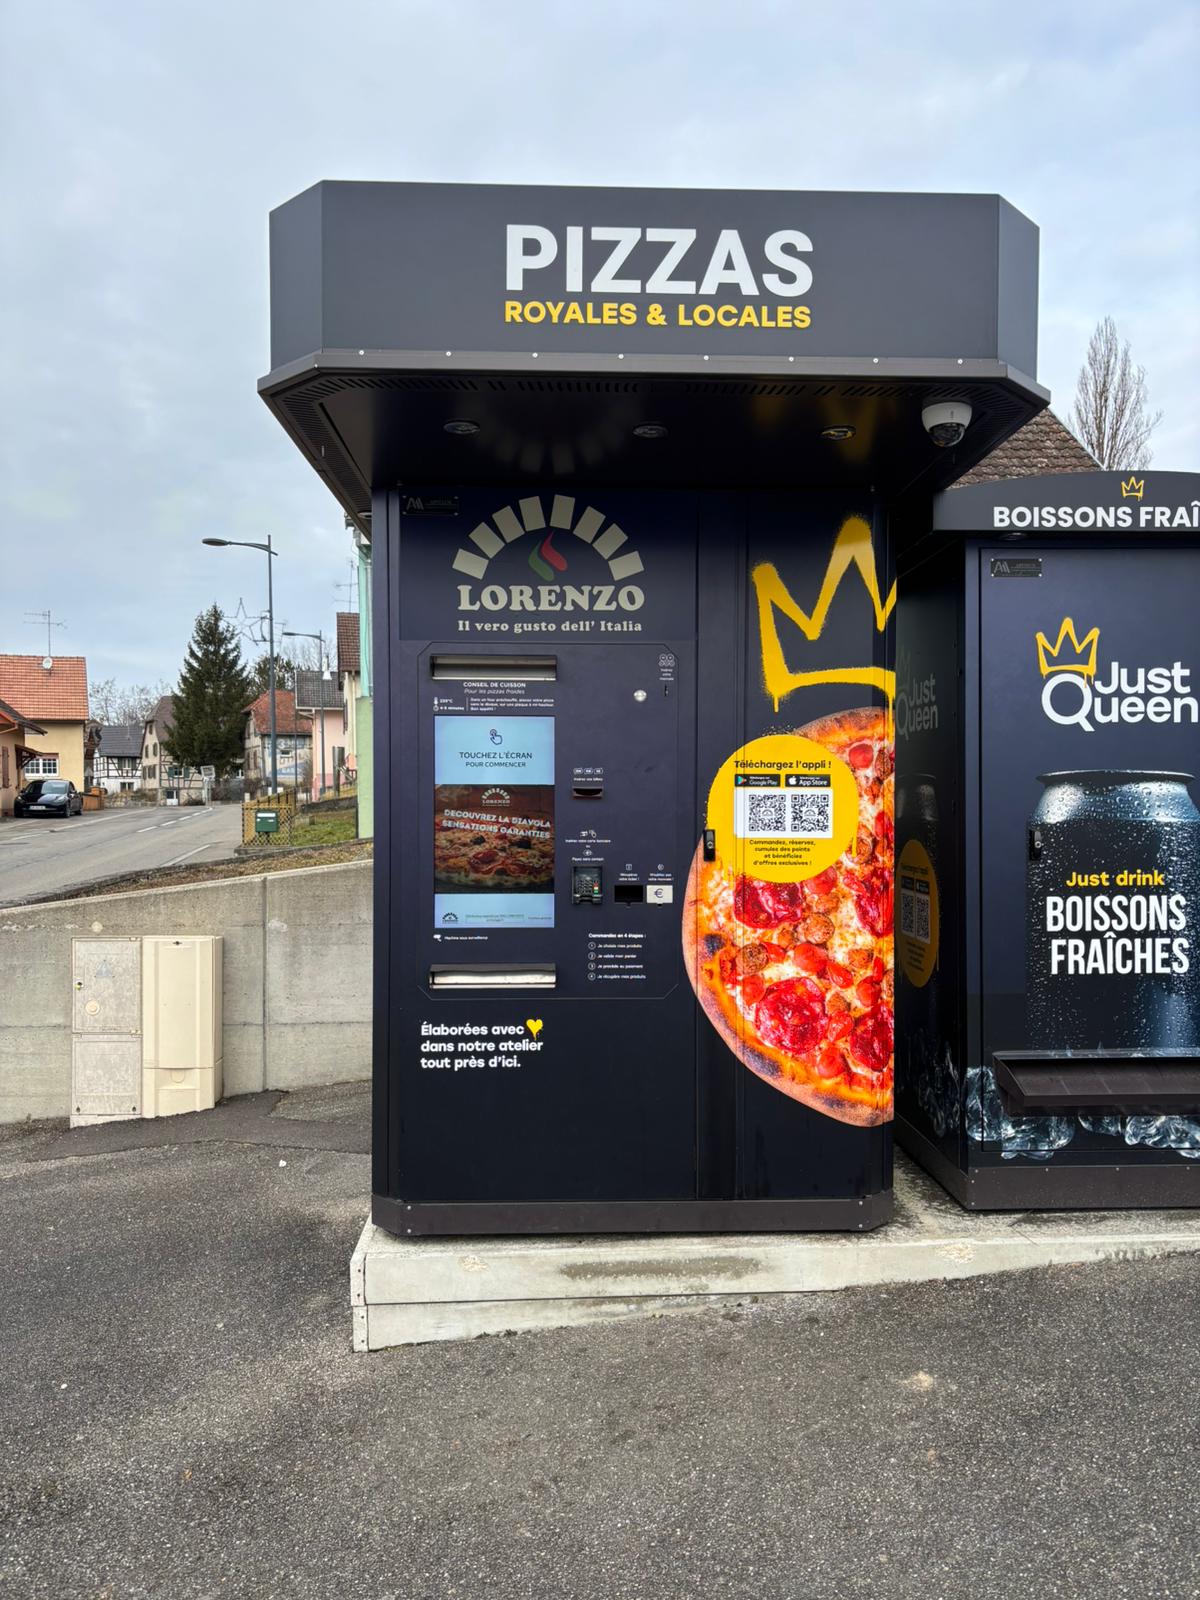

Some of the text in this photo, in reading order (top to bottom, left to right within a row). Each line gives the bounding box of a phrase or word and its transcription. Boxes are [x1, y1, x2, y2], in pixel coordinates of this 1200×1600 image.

[506, 224, 814, 297] PIZZAS
[504, 300, 812, 328] ROYALES & LOCALES
[993, 506, 1133, 528] BOISSONS
[457, 584, 645, 611] LORENZO
[457, 620, 470, 631] Il
[475, 621, 509, 631] vero
[513, 621, 556, 633] gusto
[600, 620, 642, 631] Italia
[1094, 661, 1191, 694] Just
[909, 673, 936, 707] Just
[1041, 672, 1199, 732] Queen
[896, 692, 938, 741] Queen
[734, 760, 793, 770] Téléchargez
[442, 820, 550, 839] SENSATIONS GARANTIES
[512, 817, 551, 828] DIAVOLA
[1066, 869, 1165, 887] Just drink
[1046, 894, 1187, 932] BOISSONS
[1051, 931, 1190, 975] FRAÎCHES
[421, 1021, 524, 1036] Élaborées avec
[420, 1038, 543, 1052] dans notre atelier
[420, 1057, 451, 1068] tout
[454, 1056, 485, 1071] près
